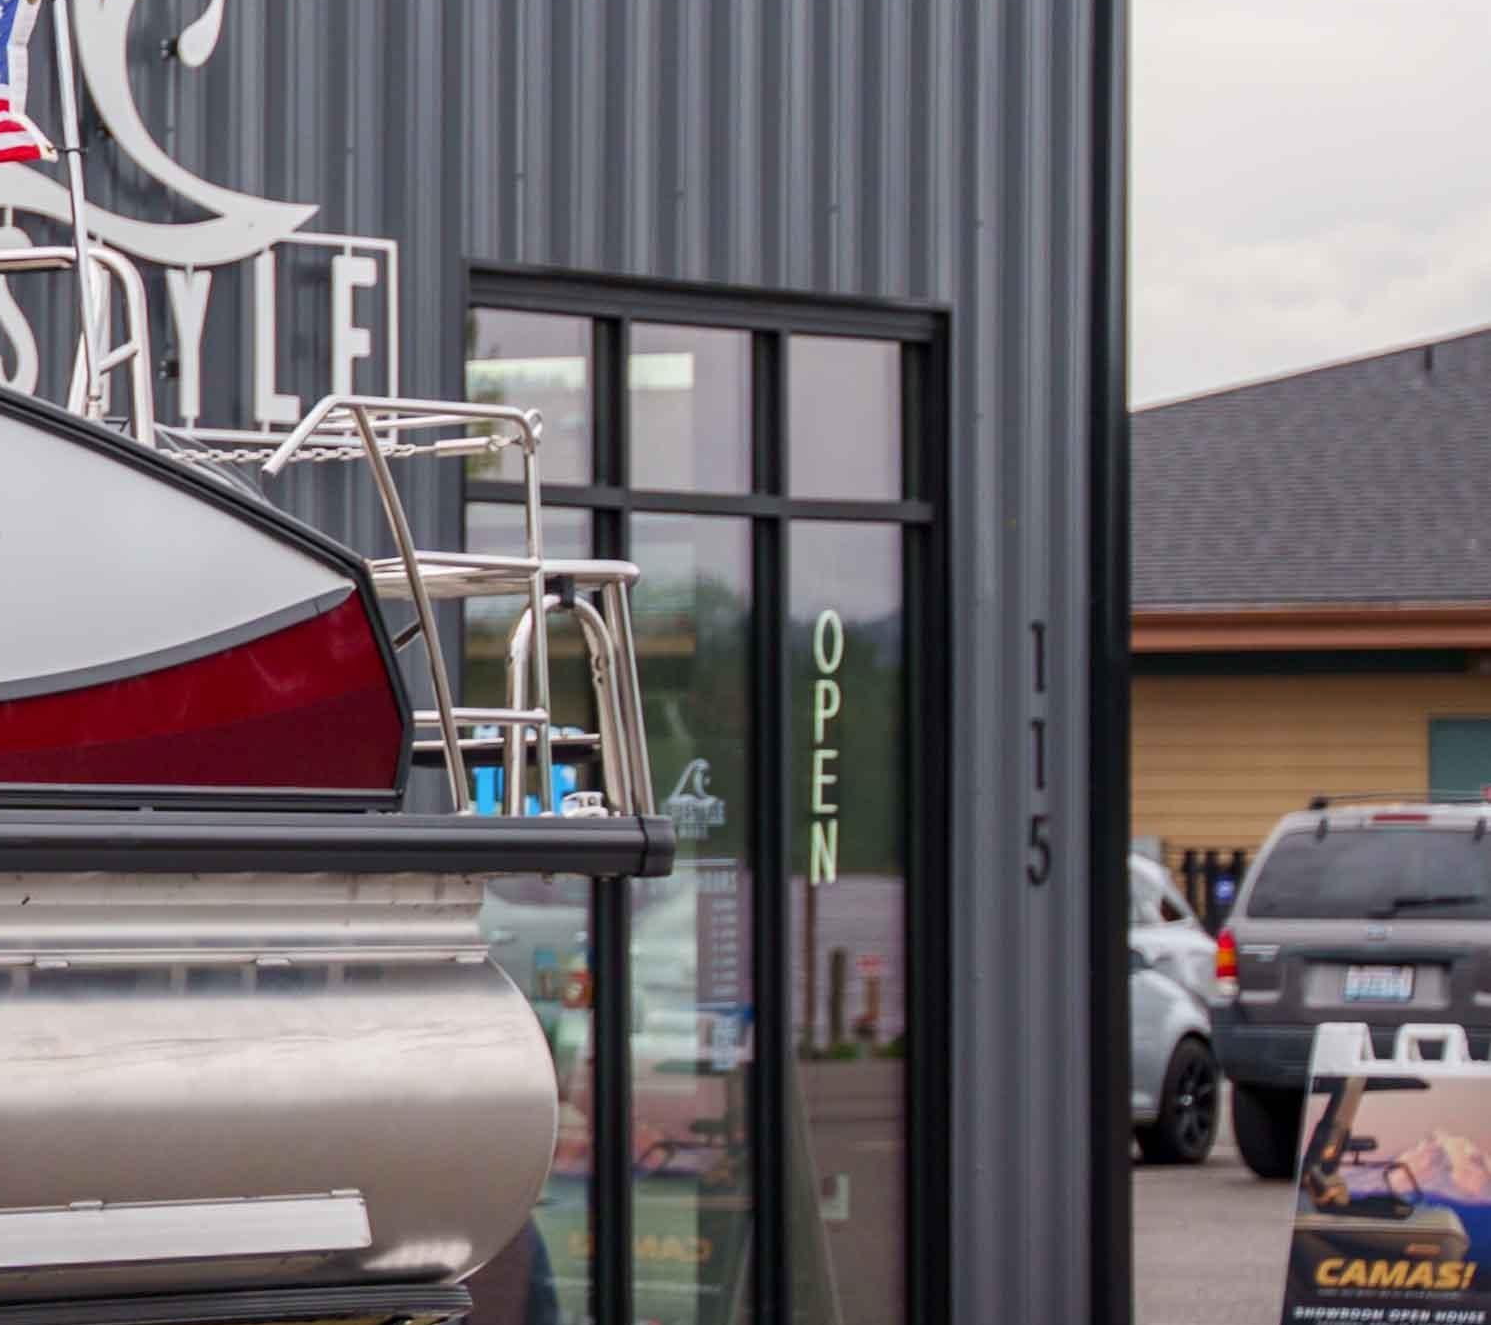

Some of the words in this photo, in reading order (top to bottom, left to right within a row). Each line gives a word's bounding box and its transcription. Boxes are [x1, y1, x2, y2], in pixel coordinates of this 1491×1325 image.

[809, 608, 845, 884] OPEN
[1026, 622, 1053, 886] 115
[1315, 1257, 1477, 1290] CAMAS!
[1389, 1307, 1431, 1322] OPEN
[1435, 1309, 1487, 1324] HOUSE
